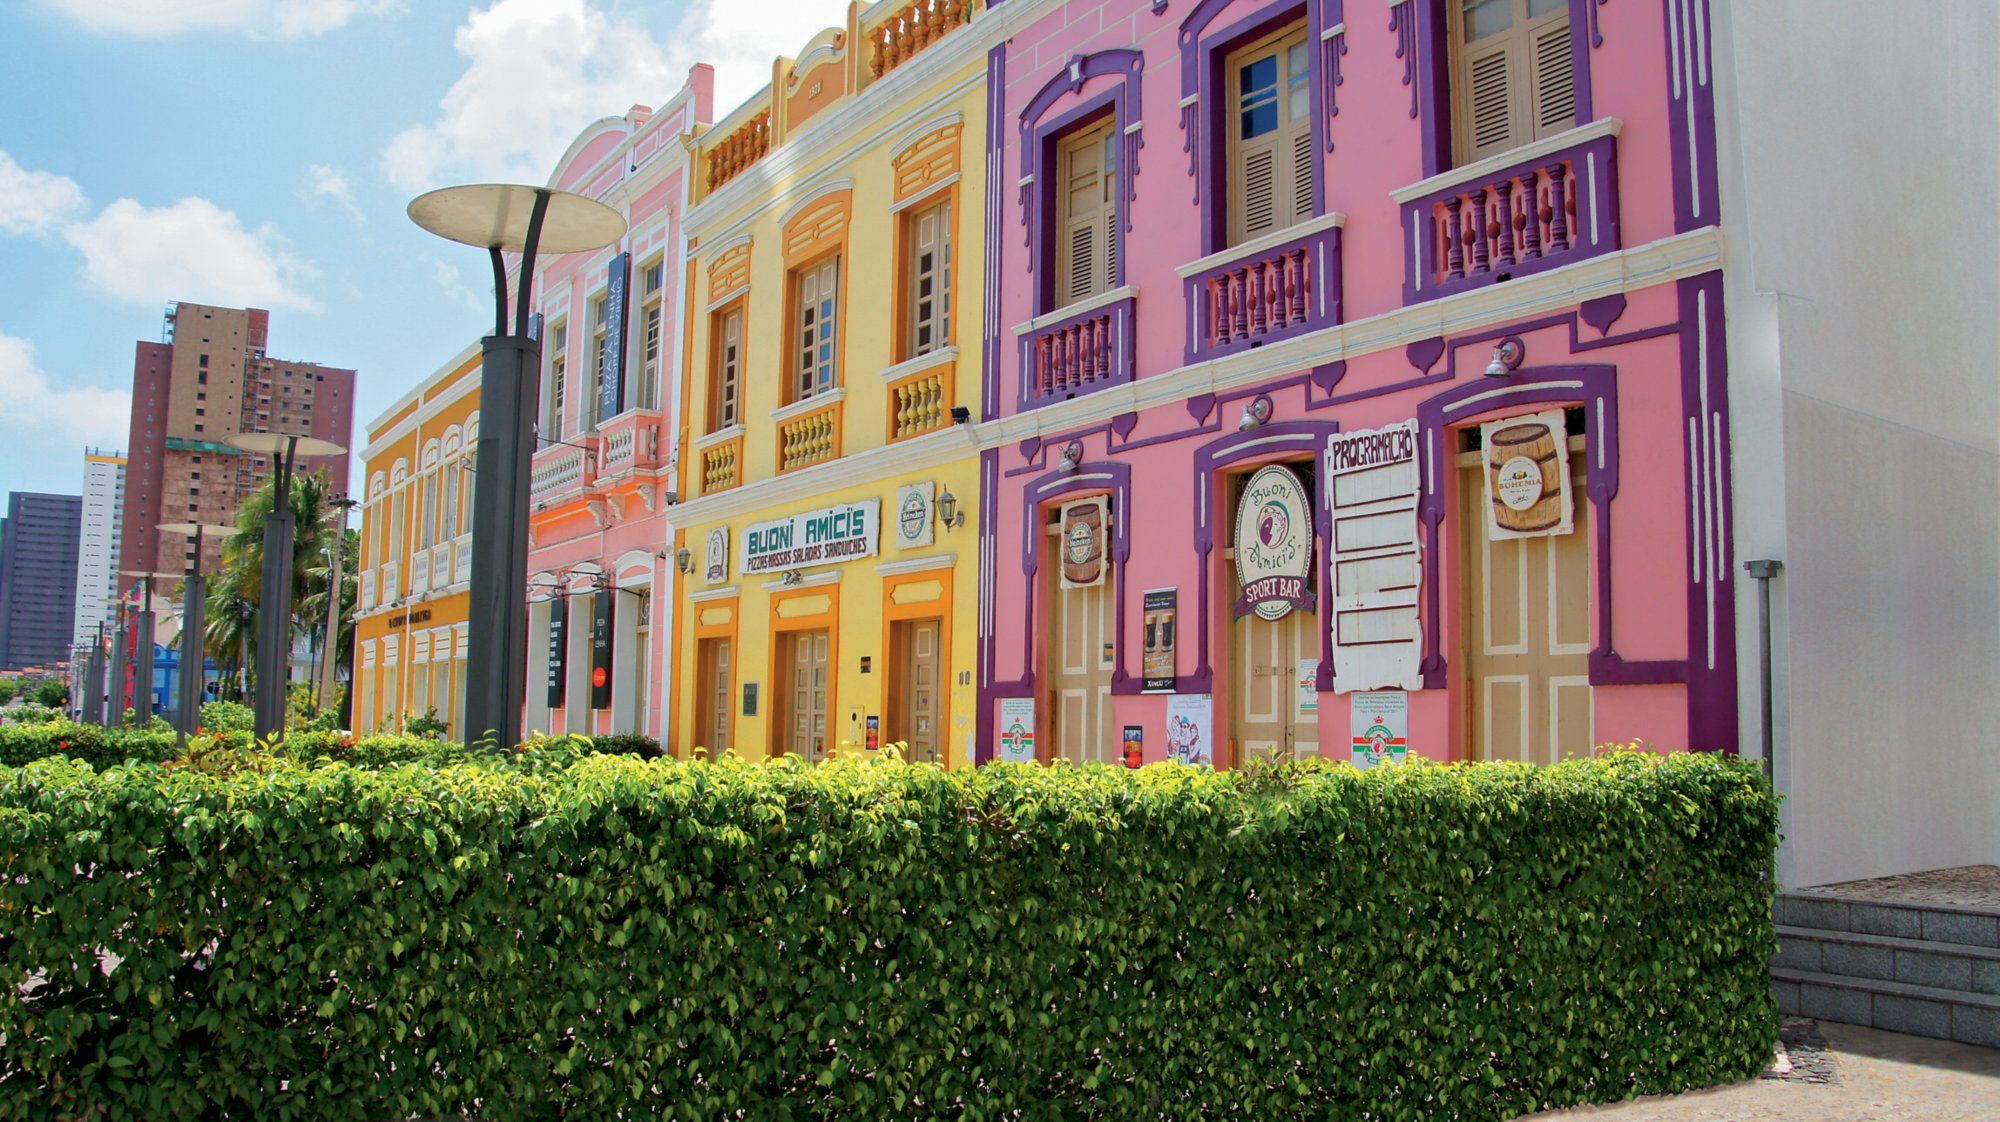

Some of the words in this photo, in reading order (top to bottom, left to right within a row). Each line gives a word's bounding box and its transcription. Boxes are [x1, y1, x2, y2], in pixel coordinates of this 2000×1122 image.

[604, 362, 612, 405] PIZZA
[1332, 424, 1413, 470] PROGRAMAÇÃO
[1250, 484, 1292, 506] Buoni
[1498, 478, 1542, 490] BOHEMIA
[1246, 577, 1277, 602] SPORT
[1280, 576, 1301, 599] BAR
